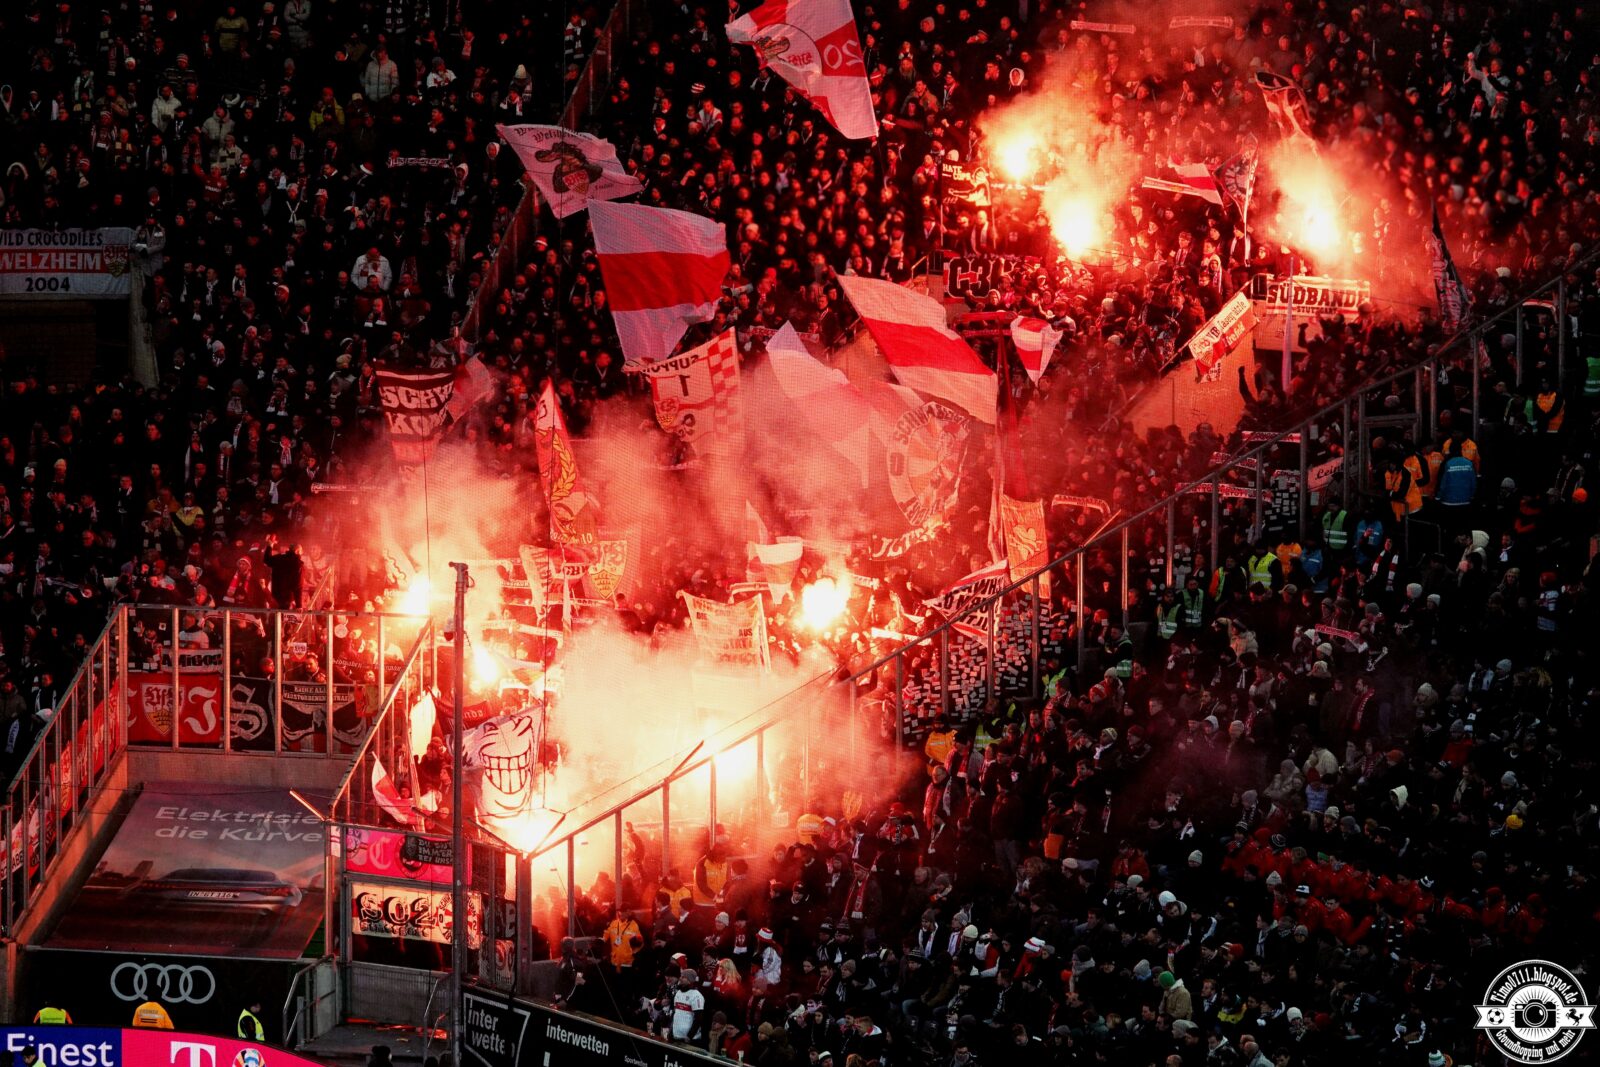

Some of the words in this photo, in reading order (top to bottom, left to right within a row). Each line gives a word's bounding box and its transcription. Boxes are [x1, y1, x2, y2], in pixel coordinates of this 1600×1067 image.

[942, 163, 963, 175] HATE
[27, 231, 104, 247] CROCODILES
[25, 276, 71, 292] 2004
[155, 825, 208, 840] die
[219, 828, 322, 842] Kurve
[467, 998, 499, 1032] inter
[471, 1030, 516, 1059] wette
[546, 1017, 610, 1057] interwetten
